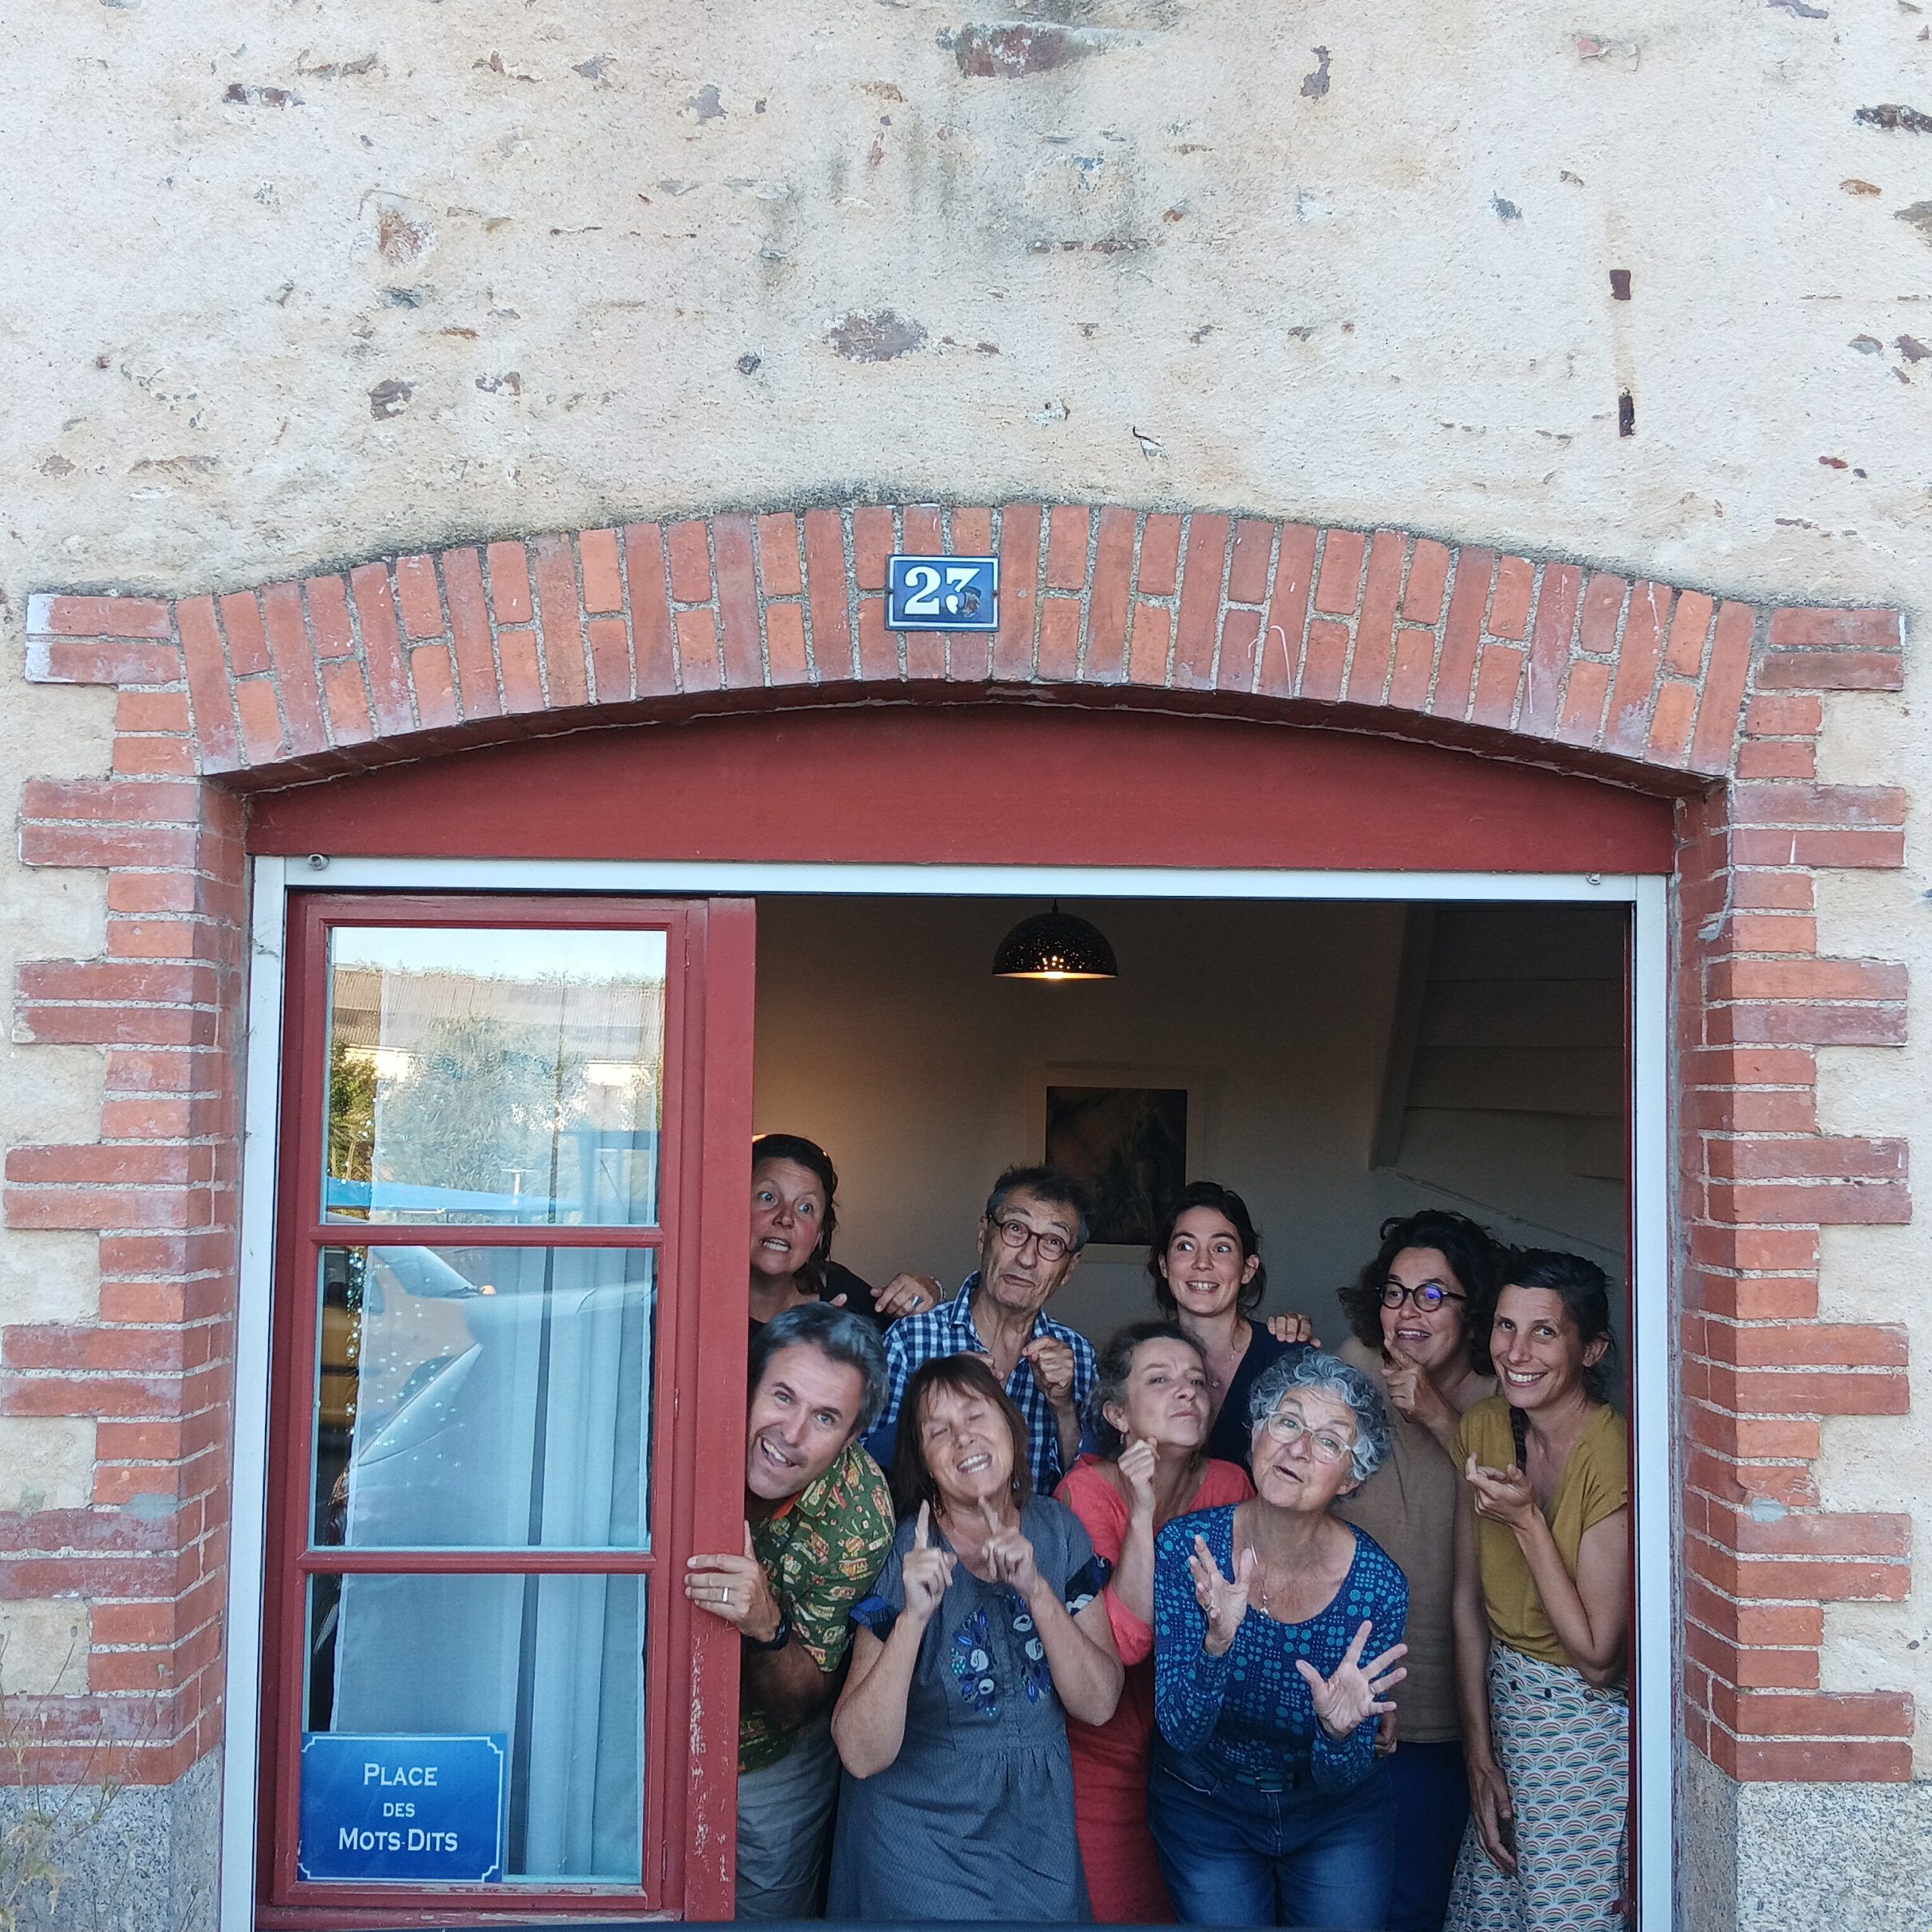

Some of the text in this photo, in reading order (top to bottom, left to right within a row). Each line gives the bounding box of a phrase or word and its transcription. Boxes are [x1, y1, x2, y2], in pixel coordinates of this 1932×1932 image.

[904, 566, 980, 616] 23
[363, 1762, 438, 1786] PLACE
[383, 1802, 415, 1817] DES
